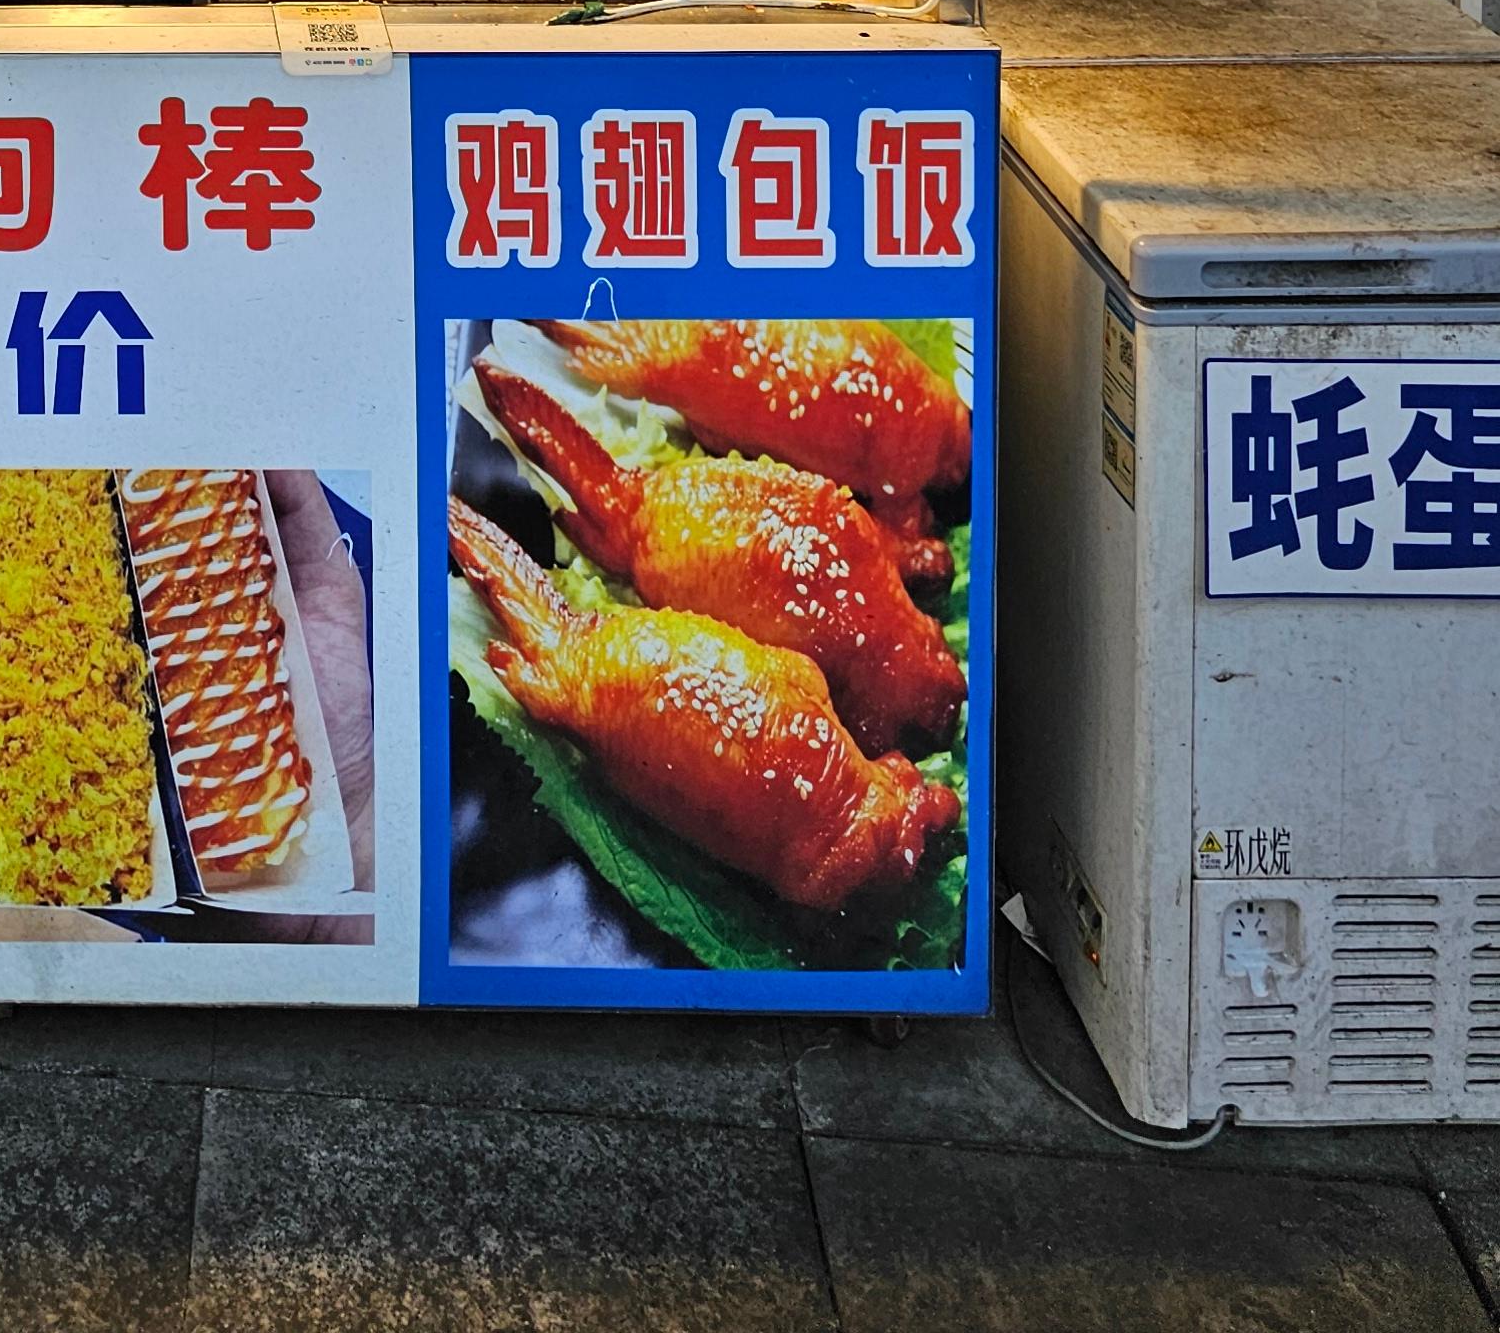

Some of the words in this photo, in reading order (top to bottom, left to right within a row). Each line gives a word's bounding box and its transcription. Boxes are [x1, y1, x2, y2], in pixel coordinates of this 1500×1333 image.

[452, 115, 968, 262] 鸡翅包饭
[1228, 374, 1500, 571] 蚝蛋
[1224, 826, 1291, 875] 环戊烷
